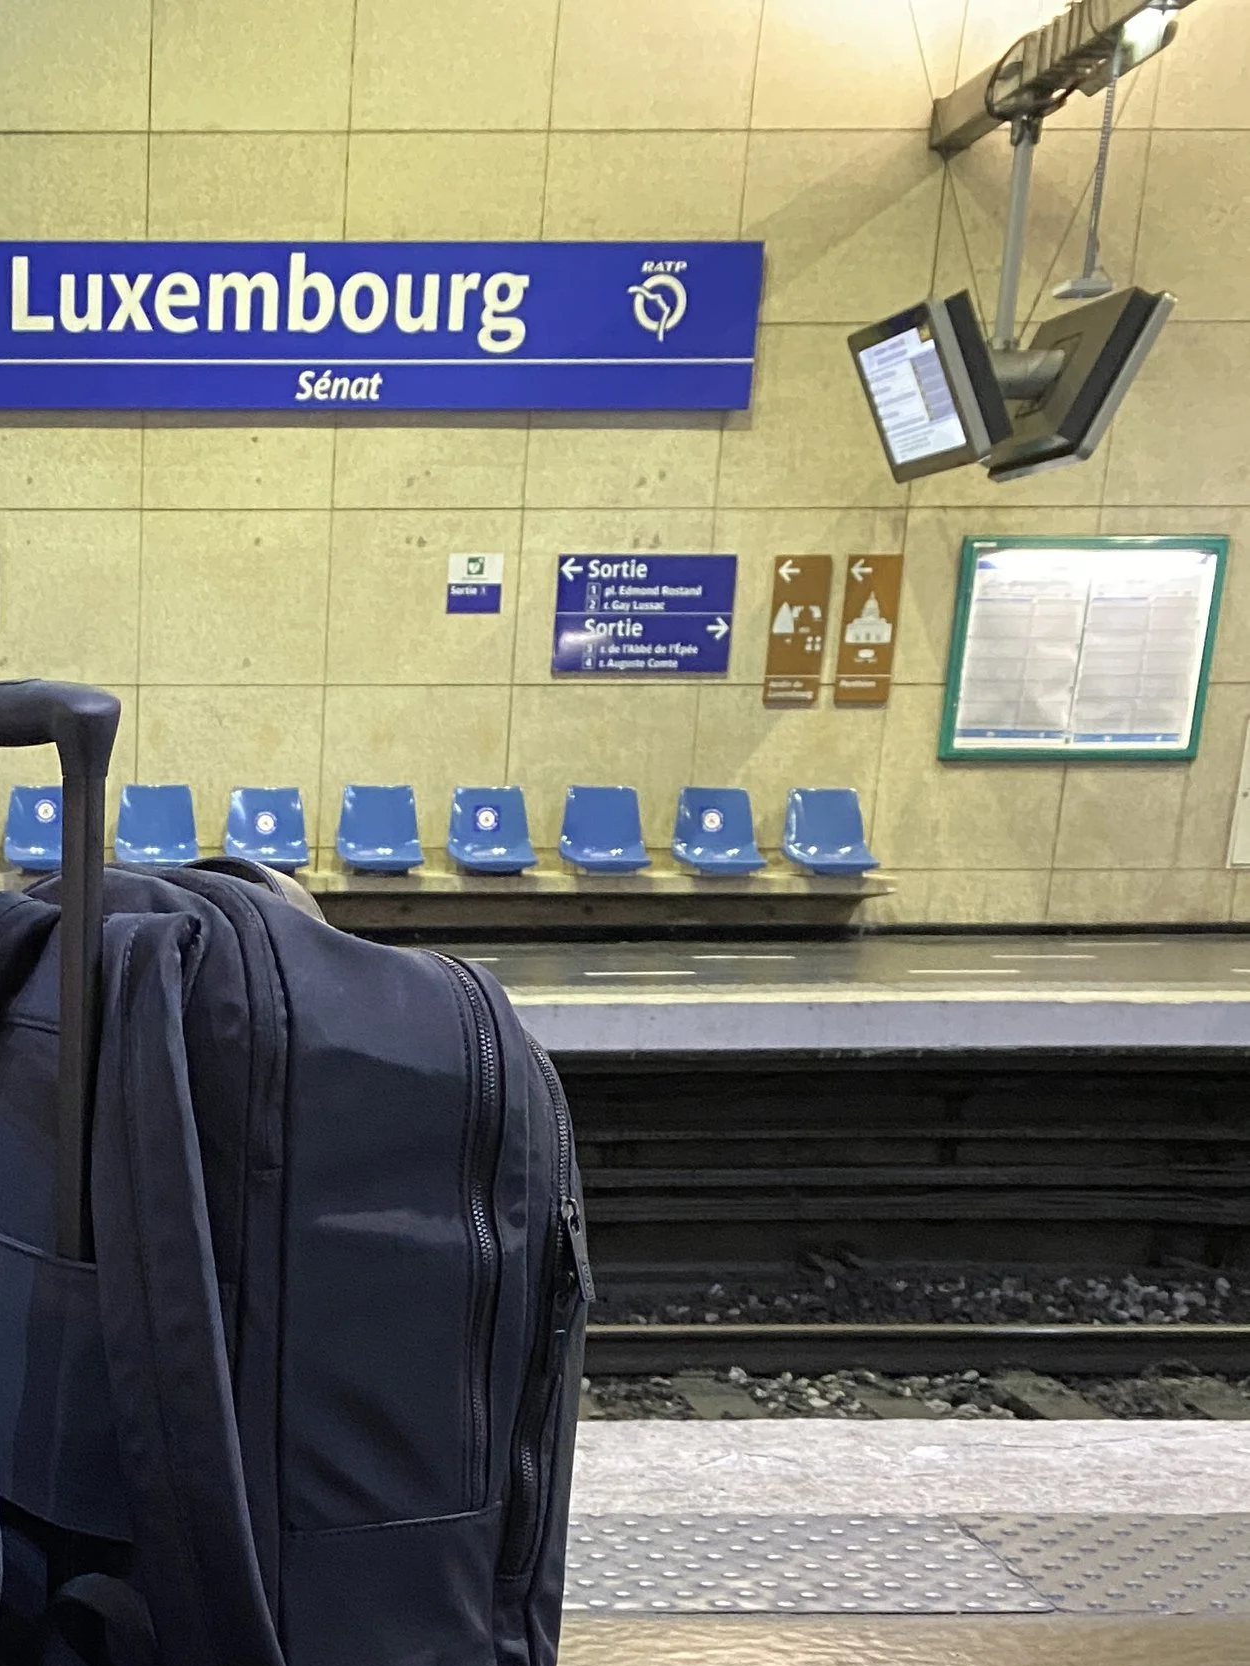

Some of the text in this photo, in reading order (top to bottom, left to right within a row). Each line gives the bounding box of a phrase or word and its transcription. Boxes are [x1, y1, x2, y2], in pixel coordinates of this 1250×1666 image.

[642, 261, 687, 272] RATP
[11, 252, 529, 353] Luxembourg
[295, 370, 382, 402] Sénat
[588, 559, 647, 579] Sortie
[450, 586, 478, 596] Sortie
[604, 586, 617, 597] pl.
[619, 586, 660, 595] Edmond
[662, 586, 702, 596] Rostand
[612, 601, 630, 612] Gay
[584, 618, 643, 637] Sortie
[608, 644, 621, 654] de
[654, 644, 667, 654] de
